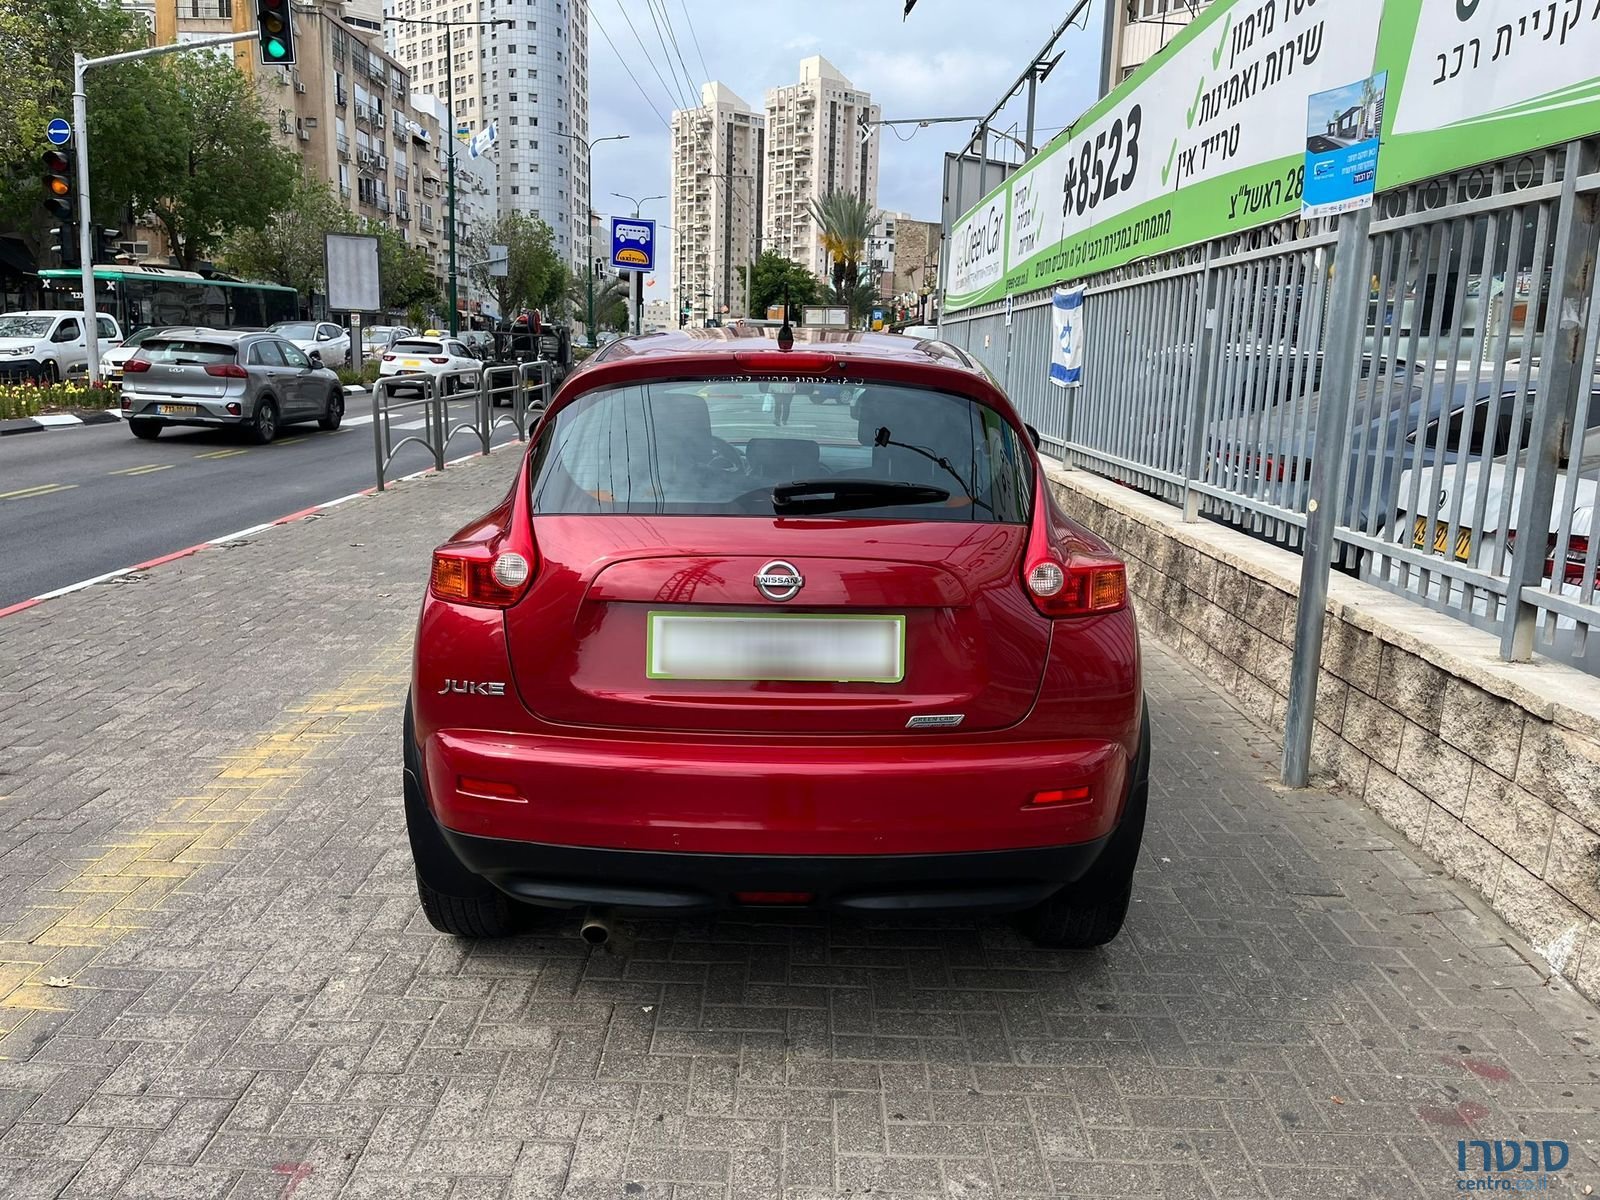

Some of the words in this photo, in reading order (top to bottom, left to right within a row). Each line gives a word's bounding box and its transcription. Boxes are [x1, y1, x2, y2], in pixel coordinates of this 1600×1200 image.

[1230, 0, 1275, 70] מימון
[1261, 20, 1324, 91] שירות
[1433, 38, 1480, 85] רכב
[1199, 61, 1259, 126] ואמינות
[1175, 145, 1197, 191] אין
[1202, 123, 1240, 170] טרייד
[1284, 164, 1305, 202] 28
[1102, 226, 1132, 256] במכירת
[1133, 209, 1171, 245] מתמחים
[760, 576, 799, 585] NISSAN
[437, 679, 505, 696] JUKE
